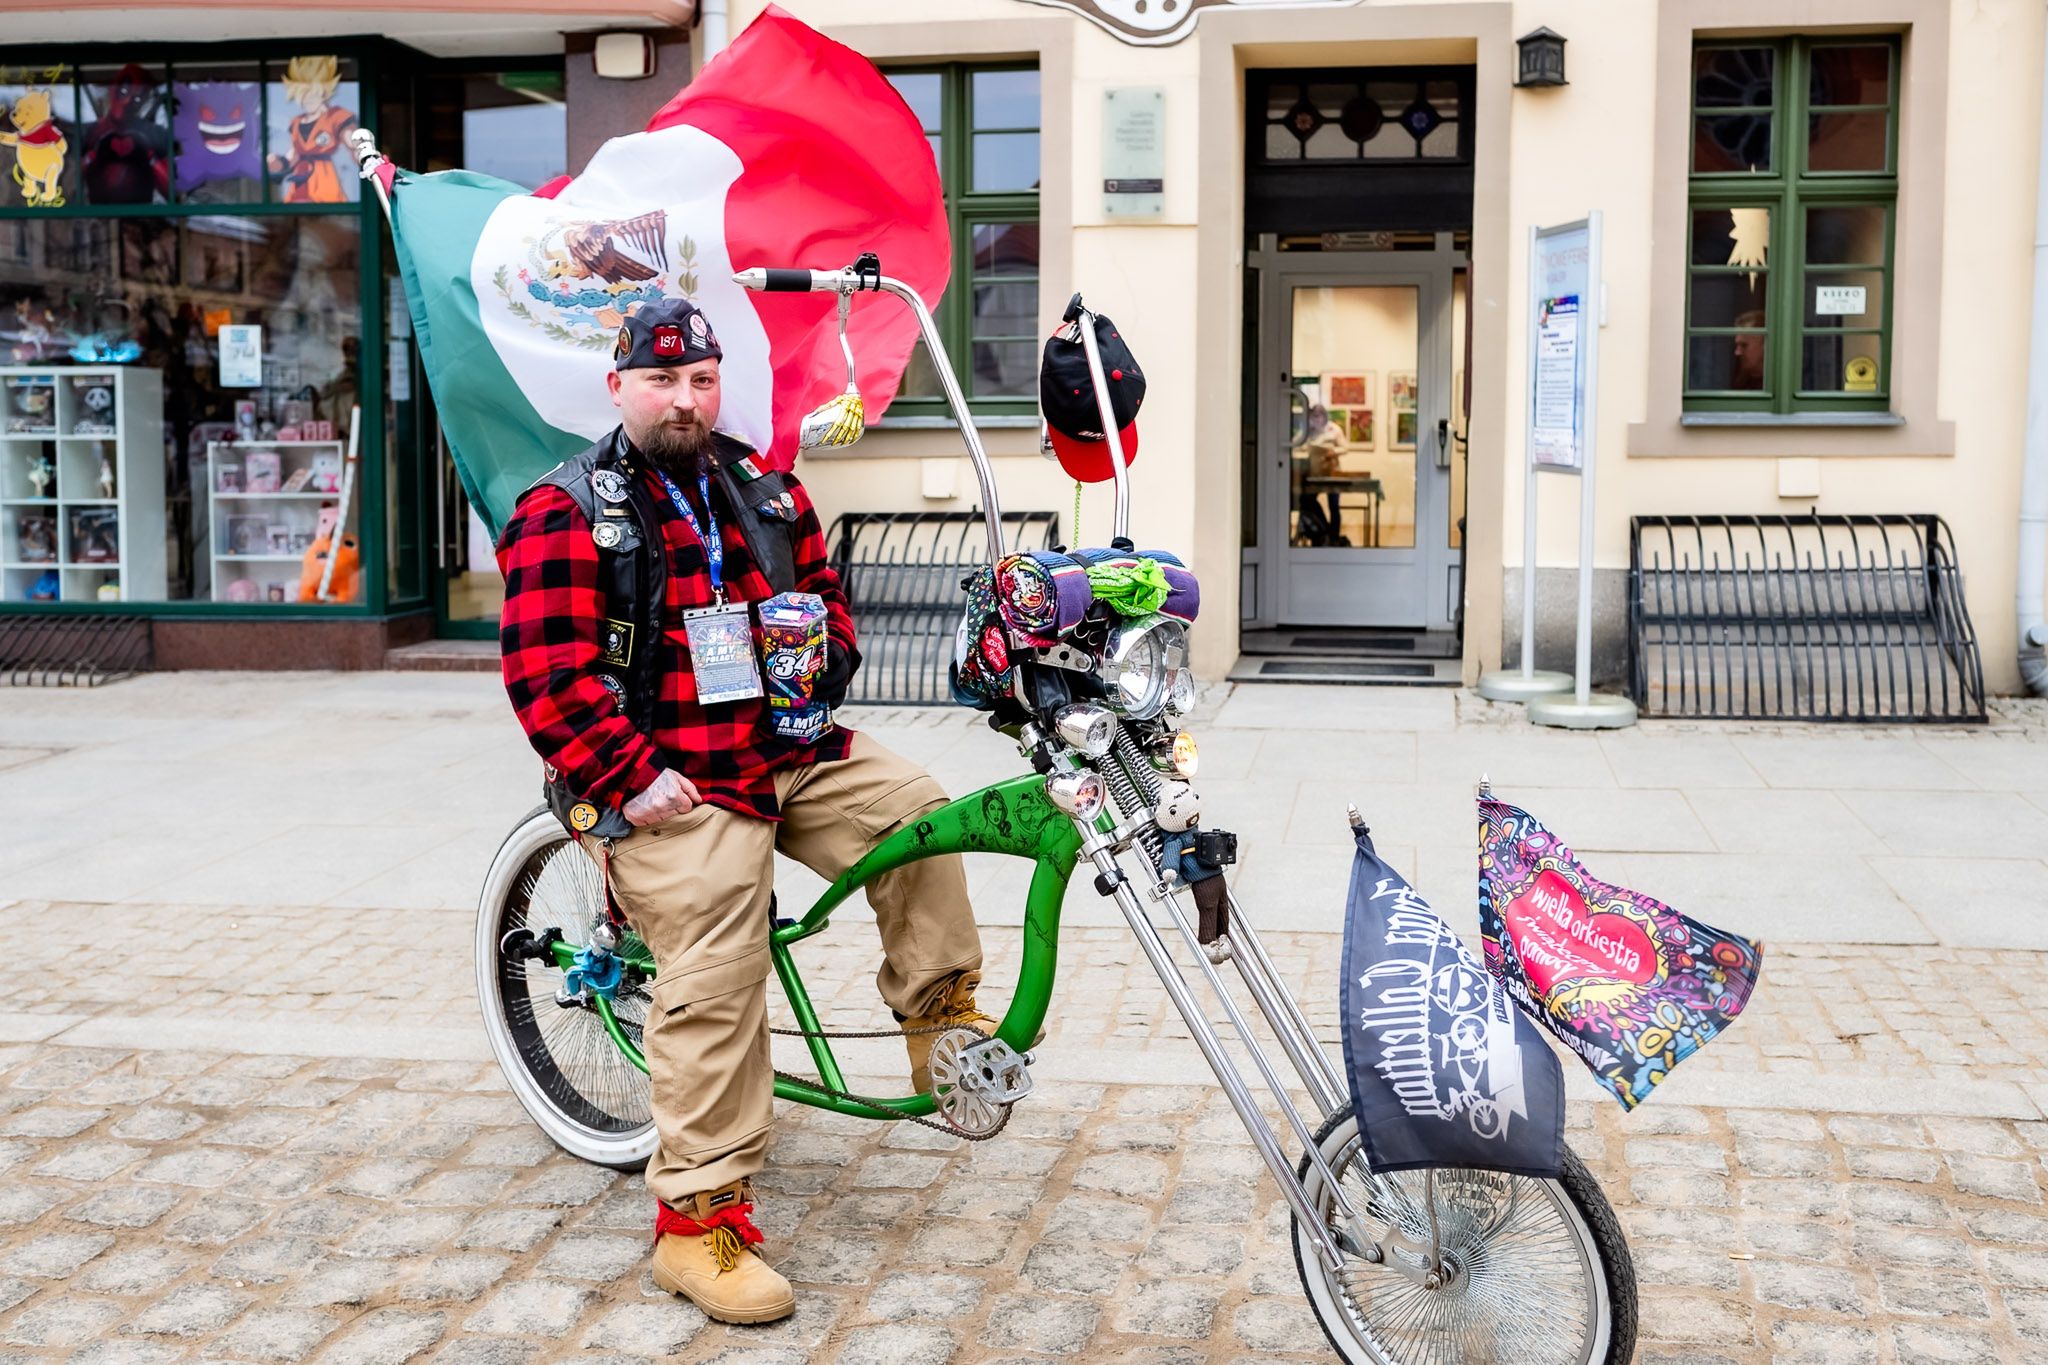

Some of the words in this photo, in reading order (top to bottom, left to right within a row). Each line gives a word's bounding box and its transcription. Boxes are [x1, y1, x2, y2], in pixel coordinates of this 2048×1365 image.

[660, 335, 678, 348] 187
[772, 645, 815, 679] 34
[778, 716, 790, 728] A
[1530, 885, 1574, 930] wielka
[1570, 918, 1640, 973] orkiestra
[1519, 934, 1579, 982] pomocy
